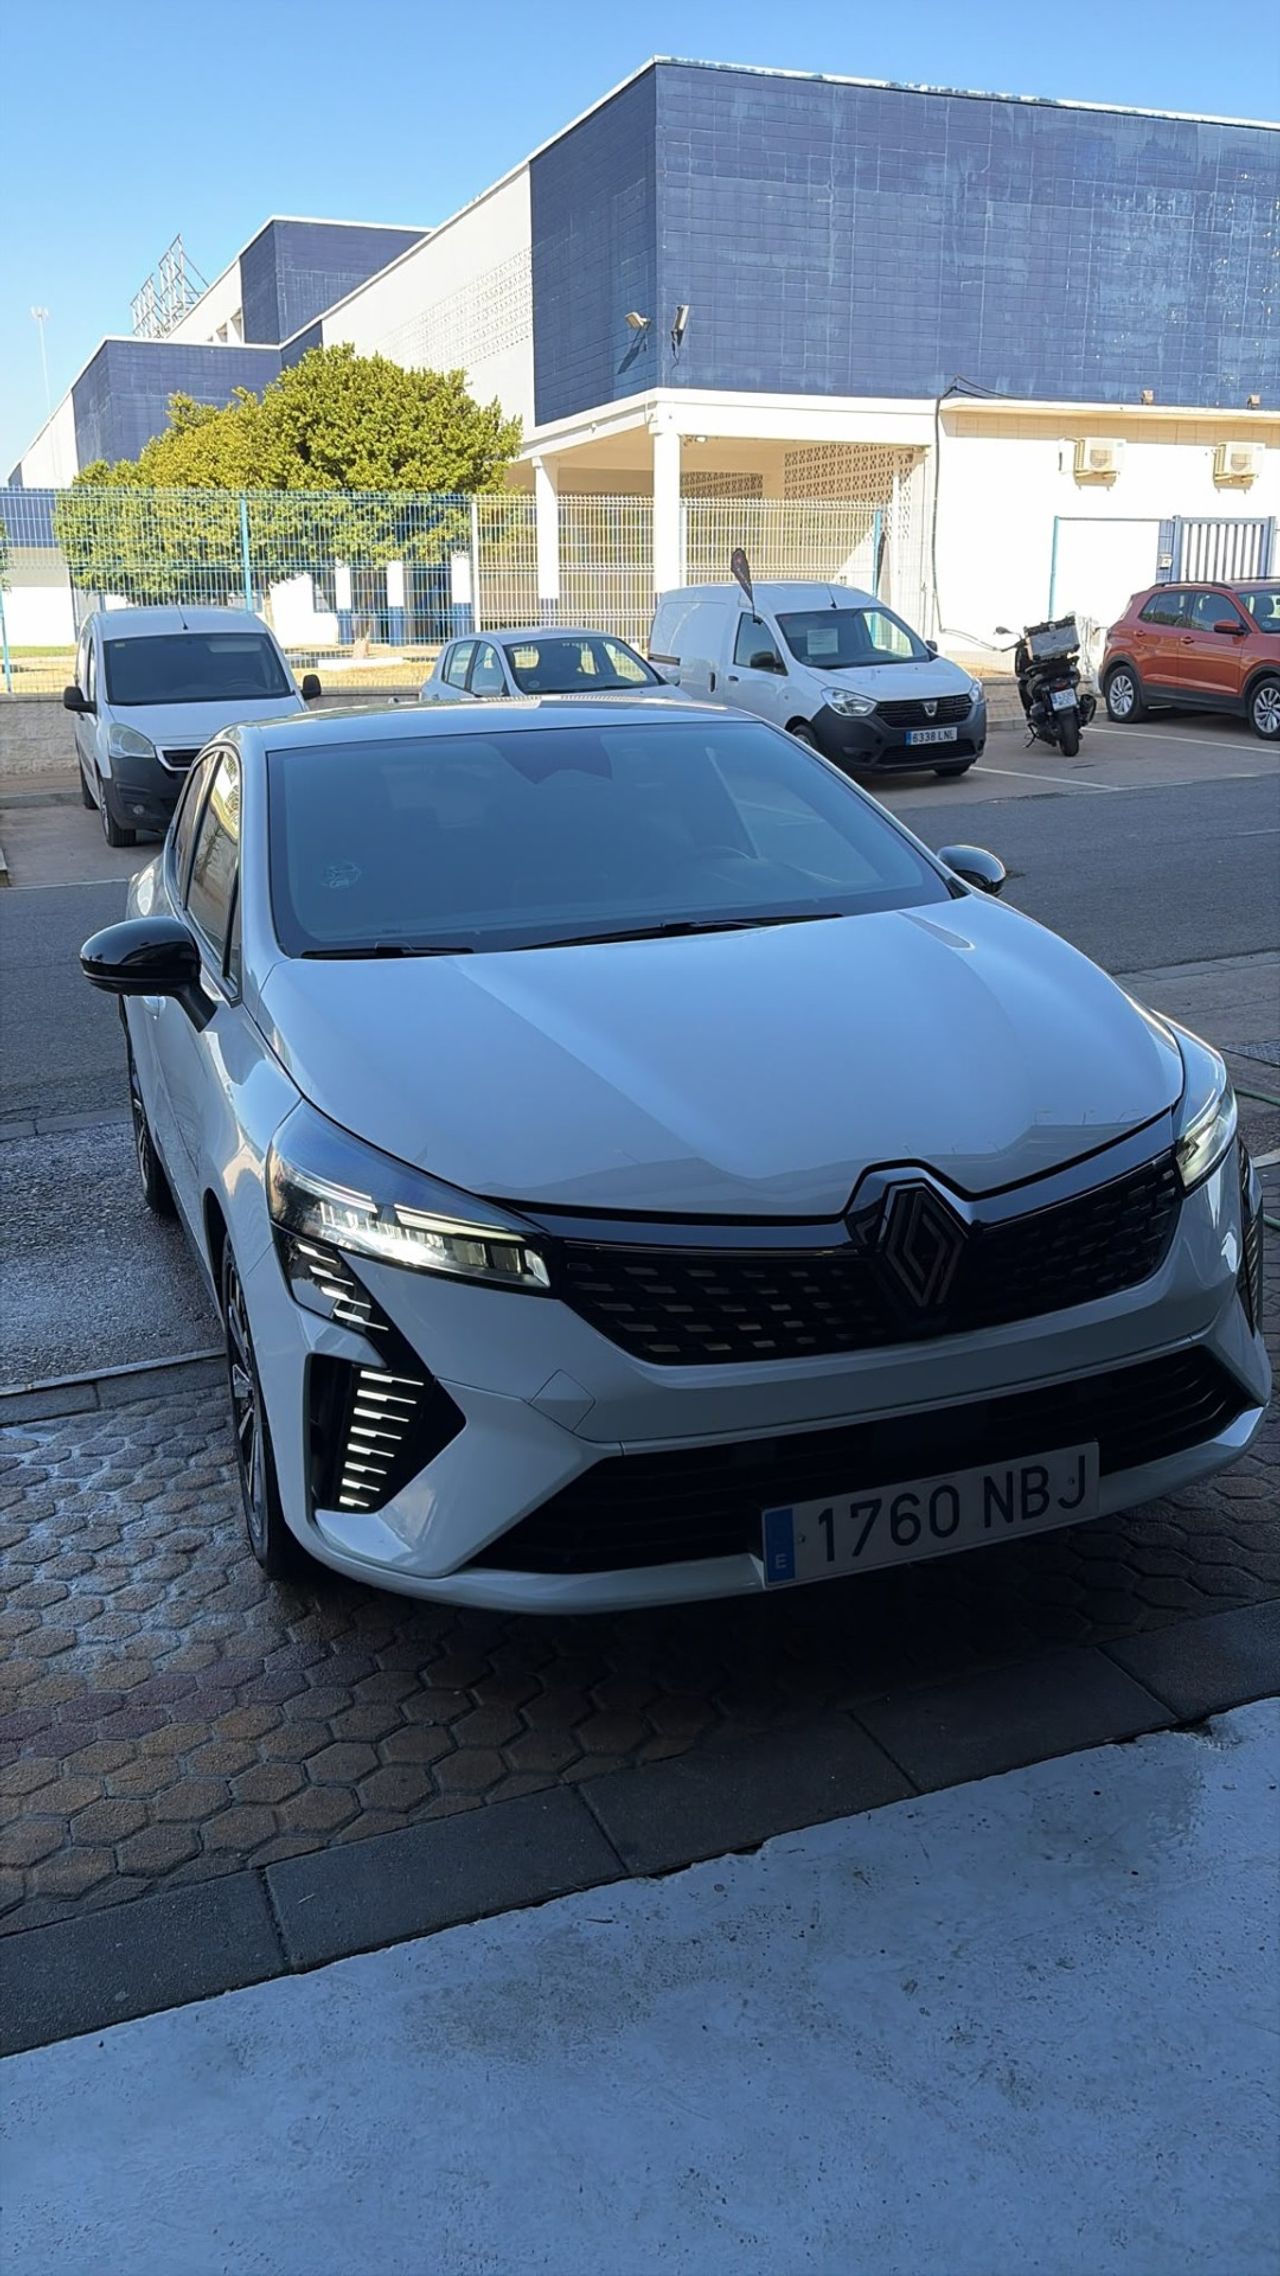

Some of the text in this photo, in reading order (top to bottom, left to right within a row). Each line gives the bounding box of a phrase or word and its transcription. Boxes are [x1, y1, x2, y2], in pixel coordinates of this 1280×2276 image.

[818, 1455, 1086, 1562] 1760 NBJ
[774, 1553, 788, 1569] E
